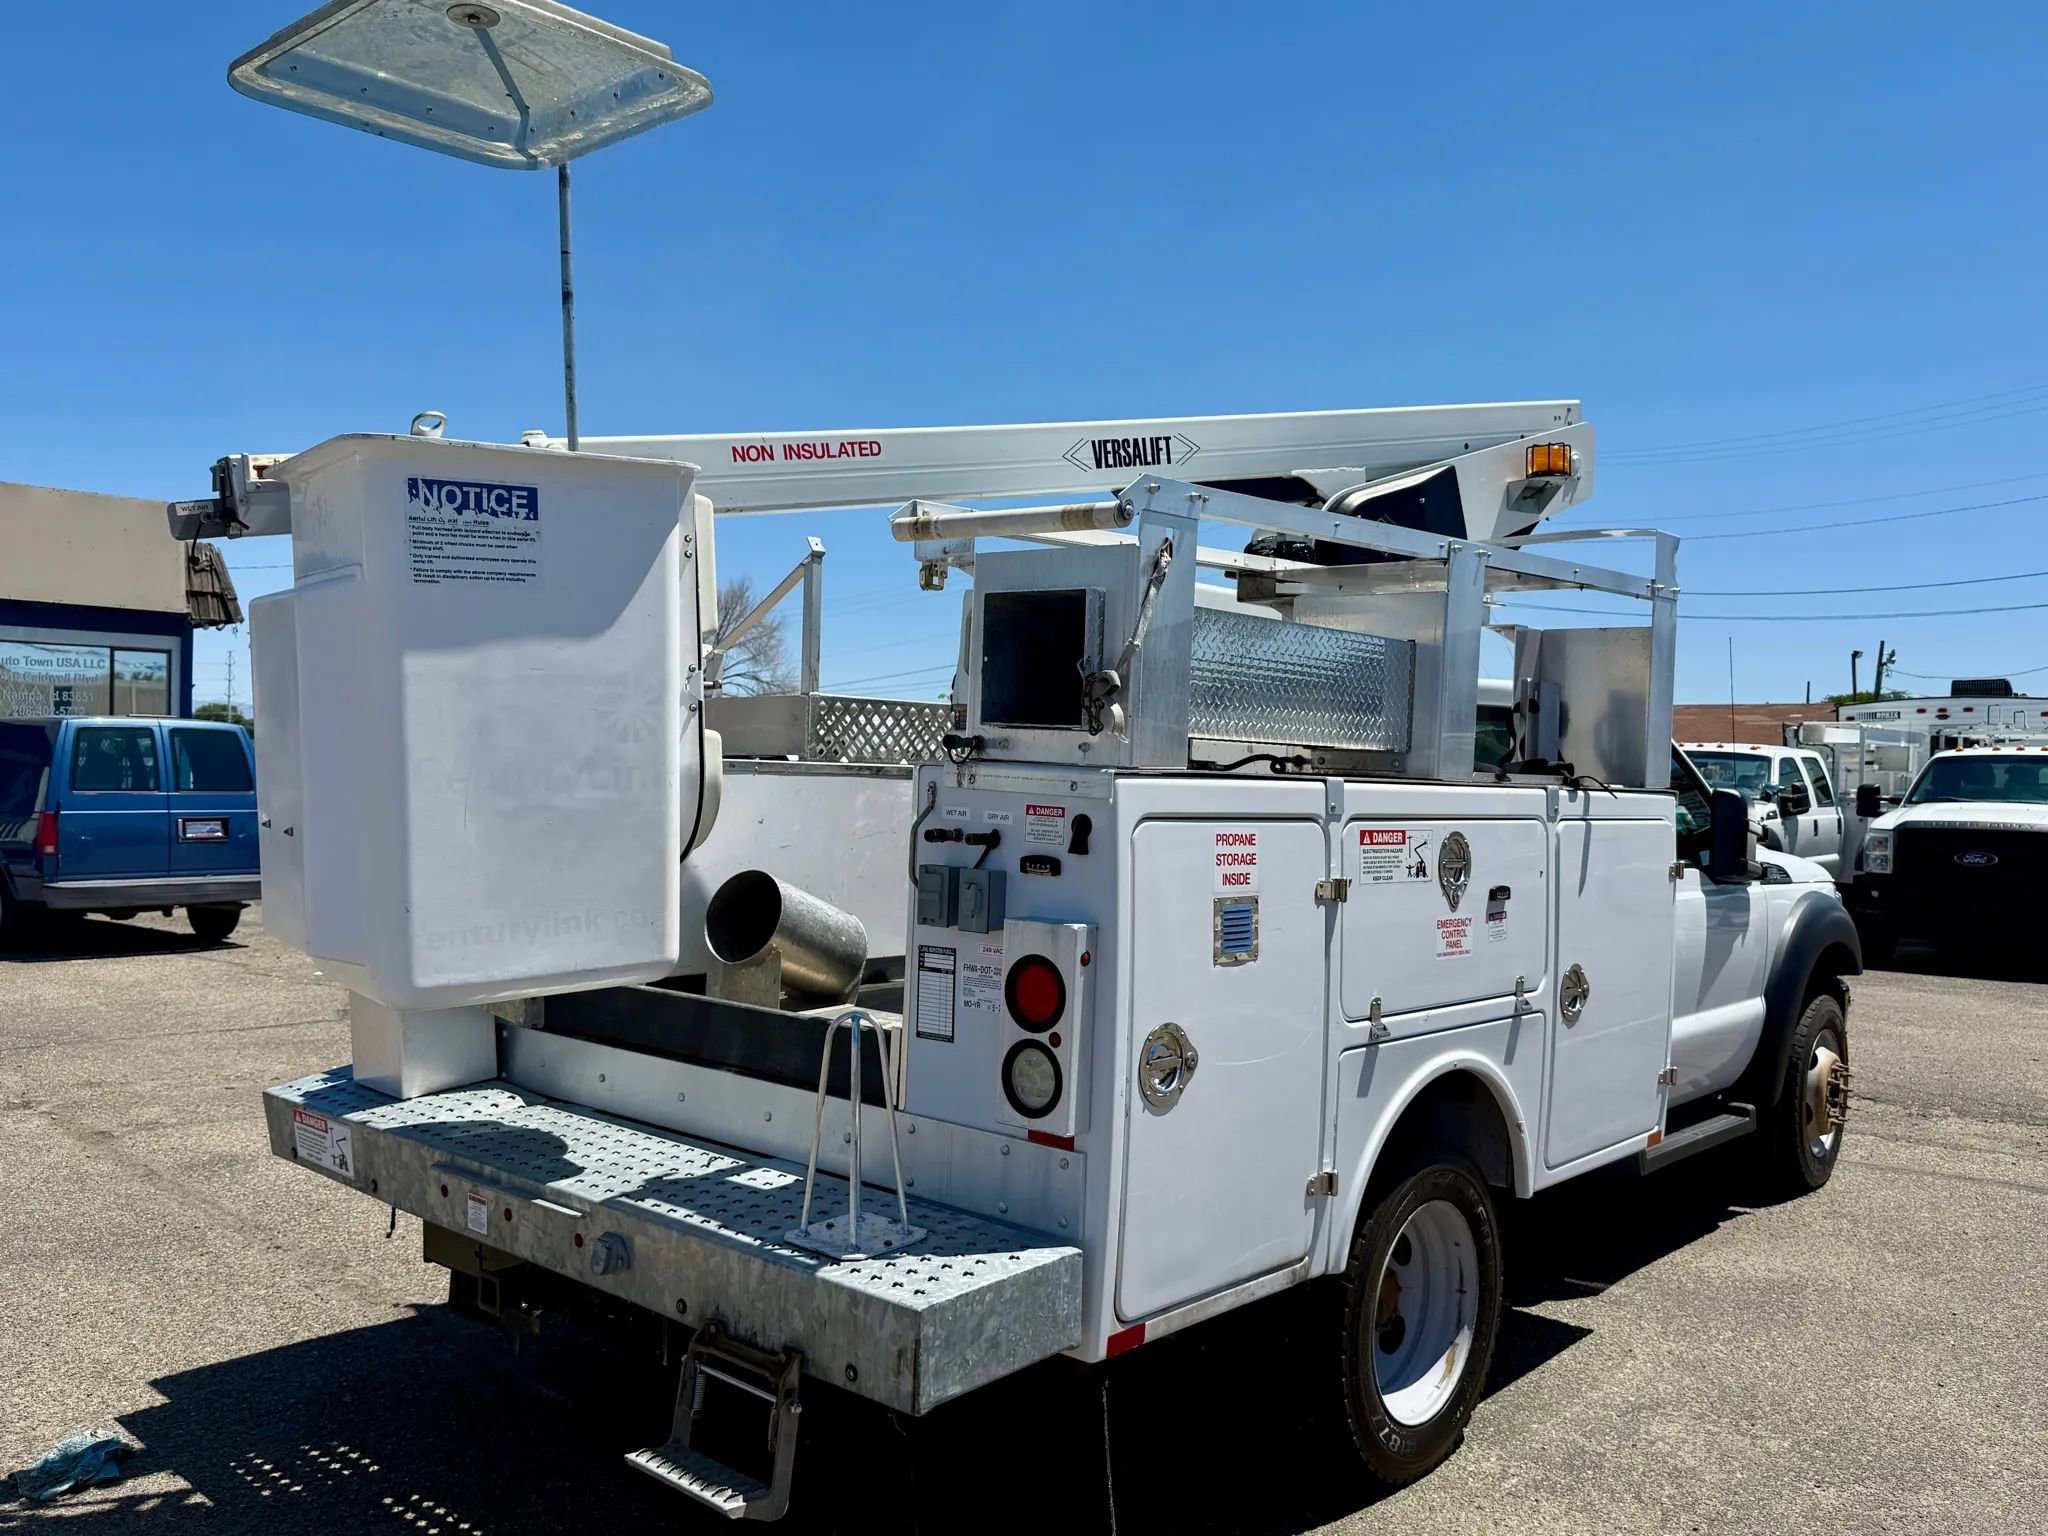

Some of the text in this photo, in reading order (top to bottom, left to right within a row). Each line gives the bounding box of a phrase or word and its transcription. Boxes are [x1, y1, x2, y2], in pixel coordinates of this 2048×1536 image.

[732, 441, 882, 463] NON INSULATED
[1091, 436, 1171, 469] VERSALIFT
[419, 484, 528, 514] NOTICE
[0, 656, 105, 669] uto Town USA LLC
[1036, 807, 1063, 816] DANGER
[1215, 833, 1256, 846] PROPANE
[1372, 832, 1403, 843] DANGER
[1215, 853, 1257, 866] STORAGE
[1963, 854, 1988, 864] Ford
[1222, 872, 1251, 886] INSIDE
[1436, 917, 1473, 930] EMERGENCY
[1441, 929, 1468, 940] CONTROL
[1445, 939, 1463, 950] PANEL
